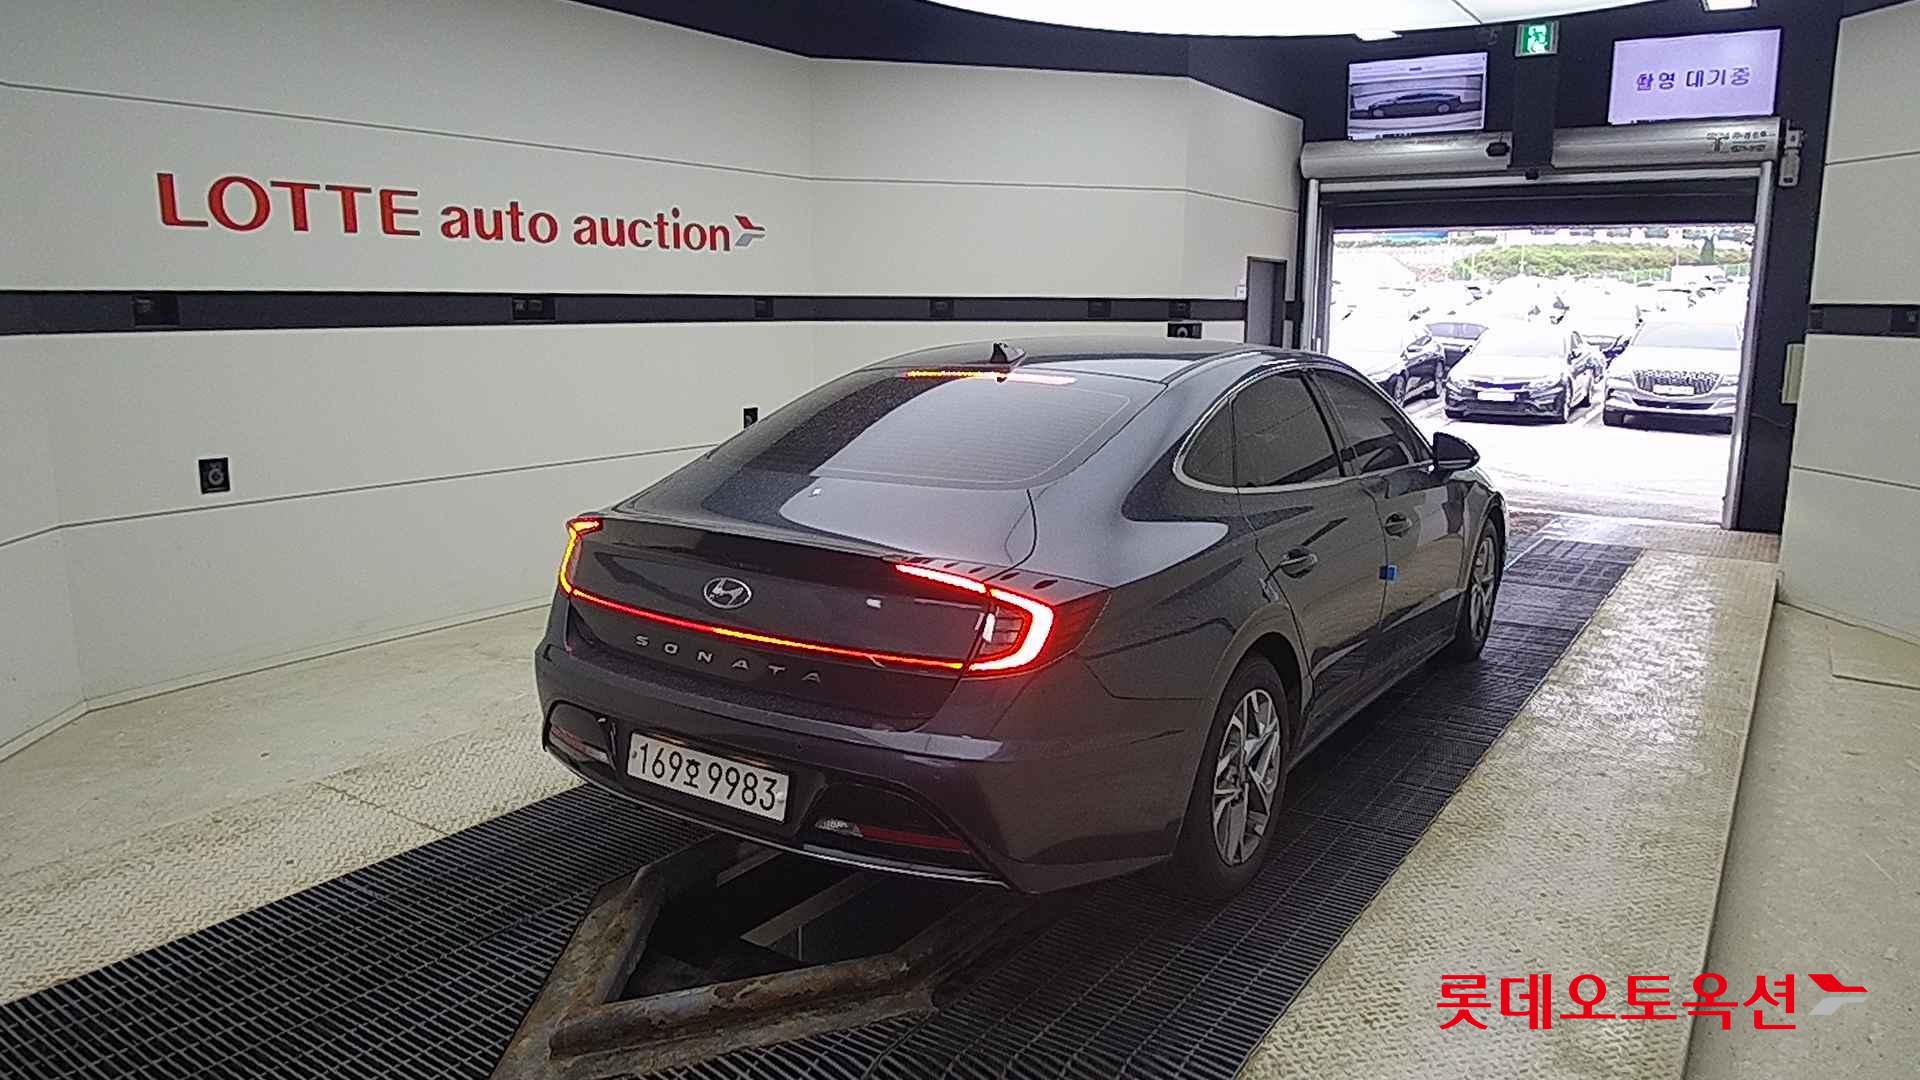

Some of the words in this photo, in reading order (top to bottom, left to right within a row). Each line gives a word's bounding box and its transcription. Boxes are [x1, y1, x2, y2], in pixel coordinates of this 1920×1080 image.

[1636, 71, 1675, 91] 촬영
[1686, 66, 1750, 88] 대기중
[156, 172, 421, 237] LOTTE
[439, 201, 559, 244] auto
[572, 207, 731, 252] auction
[634, 634, 822, 683] SONATA
[639, 742, 778, 812] 169호9983
